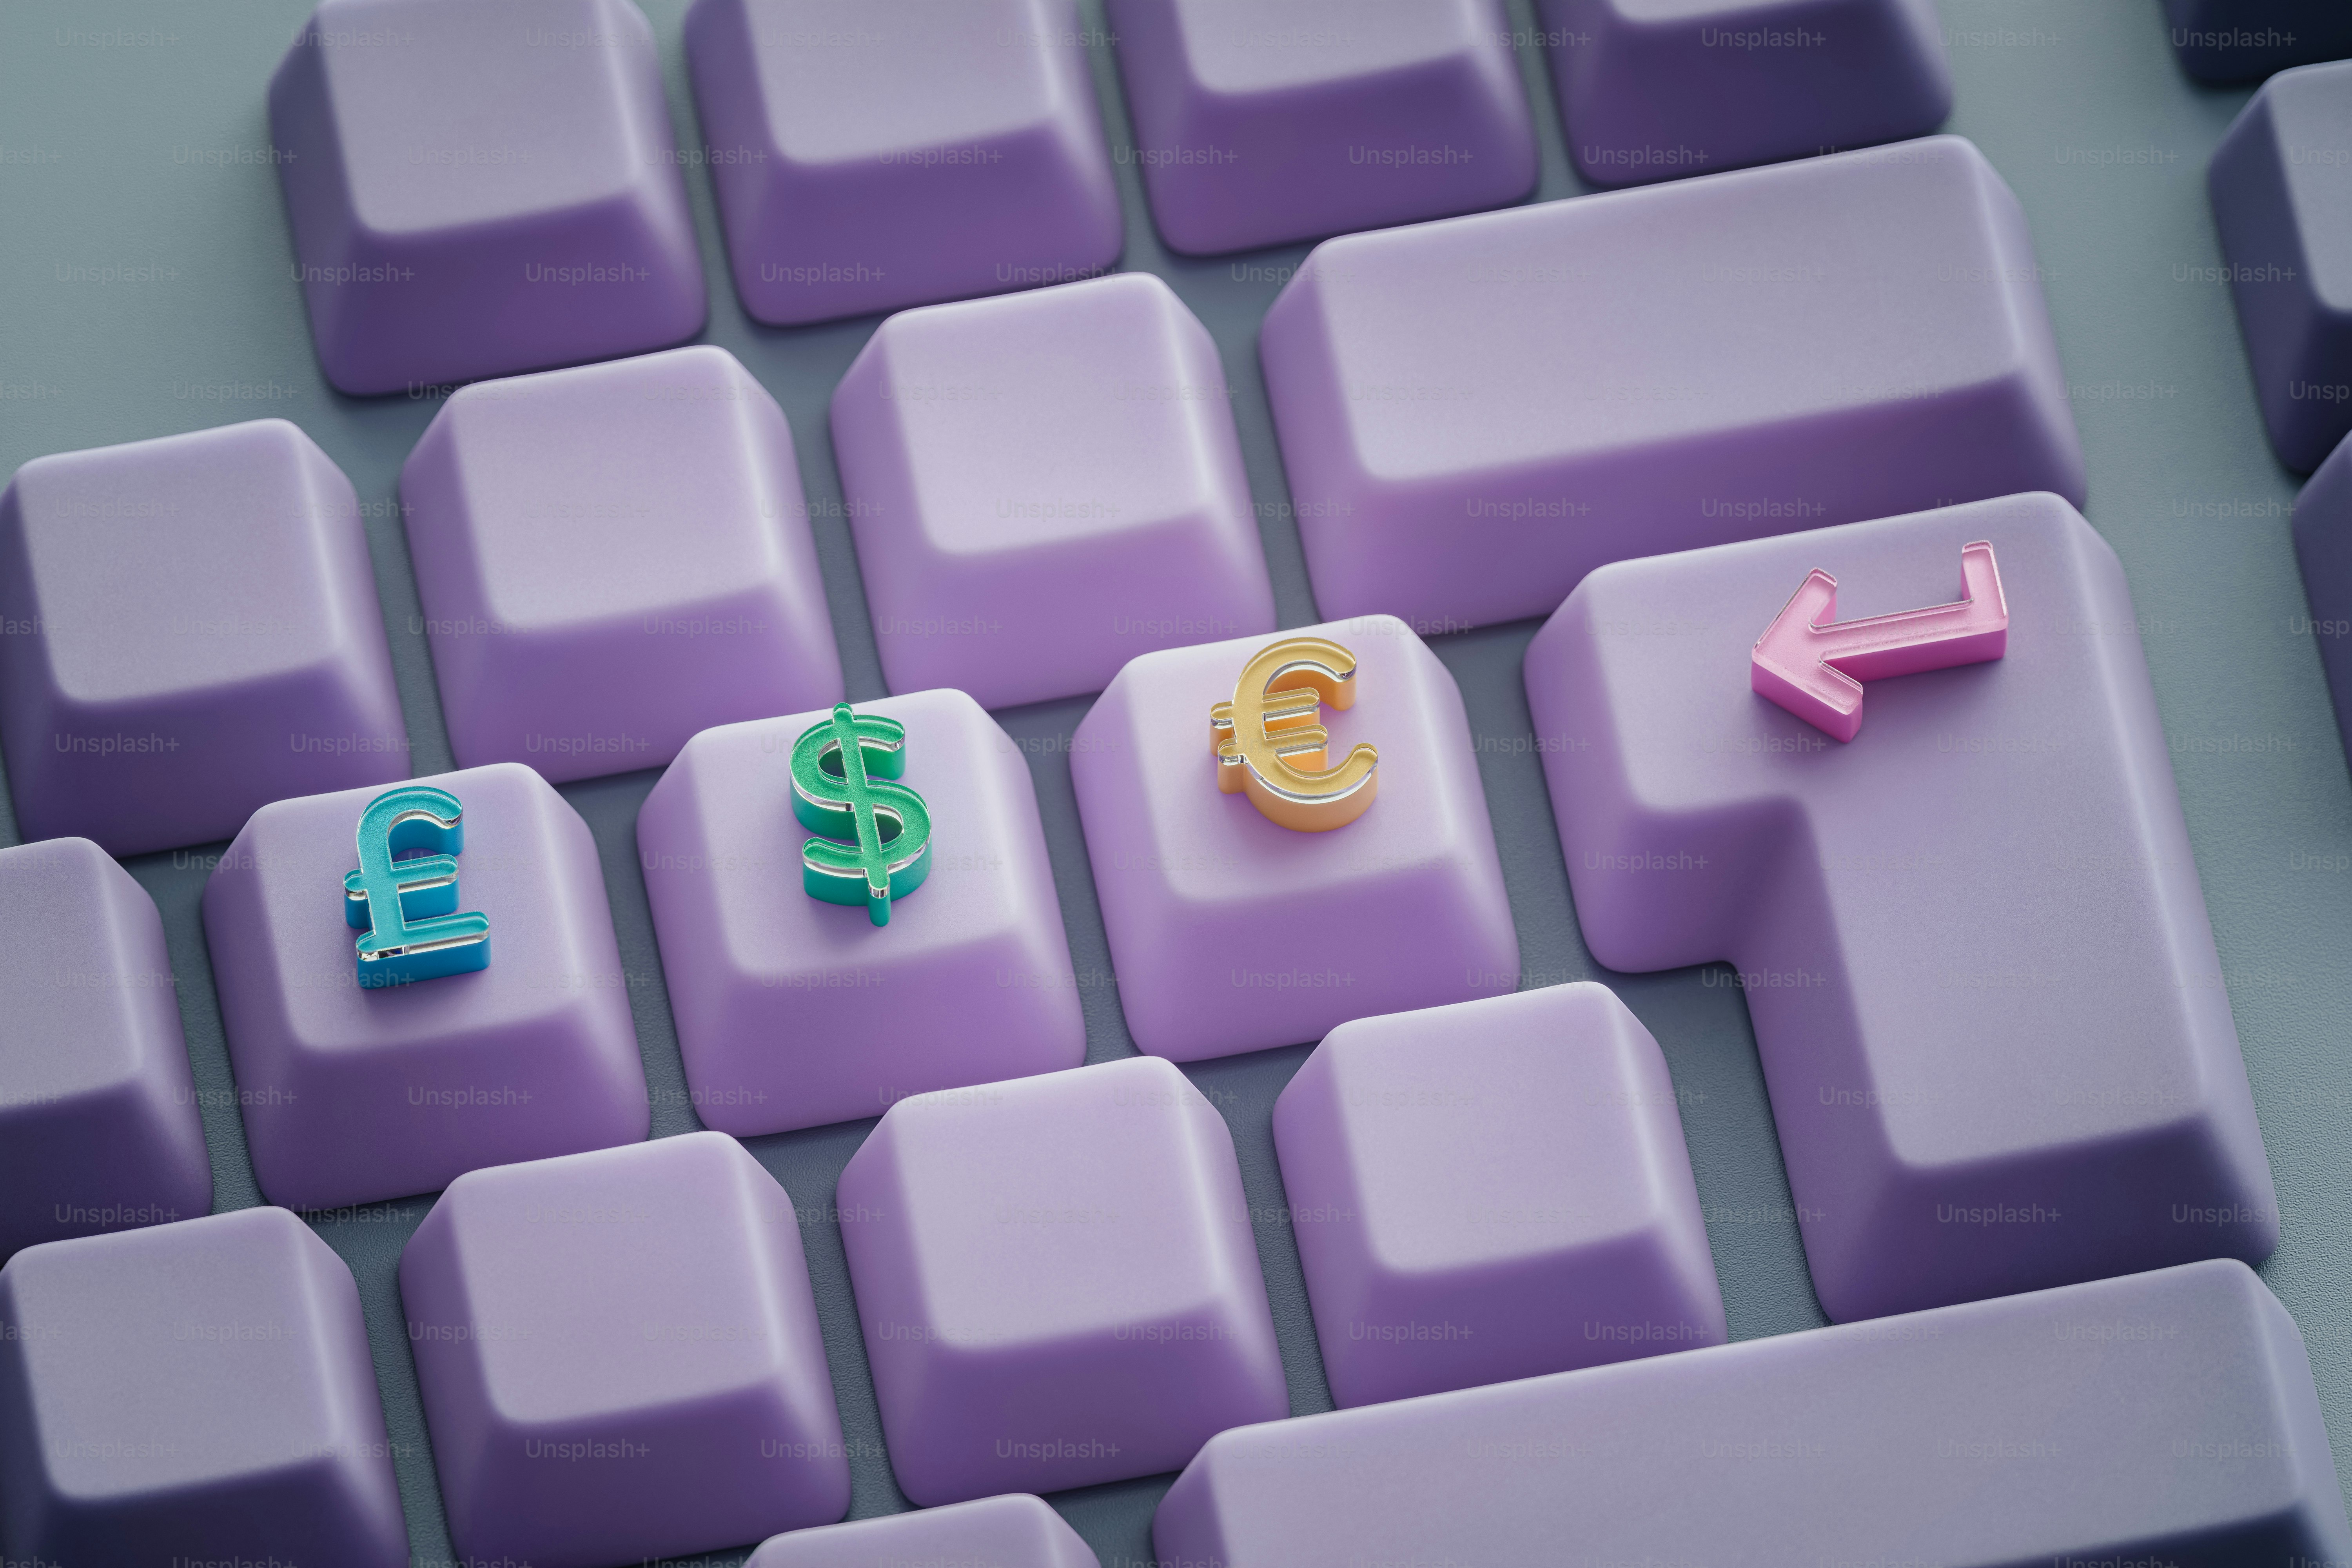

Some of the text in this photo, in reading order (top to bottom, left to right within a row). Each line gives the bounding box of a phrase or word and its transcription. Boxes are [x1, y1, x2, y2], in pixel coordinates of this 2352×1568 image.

[789, 702, 932, 927] $
[1210, 637, 1378, 833] €
[343, 786, 491, 989] £
